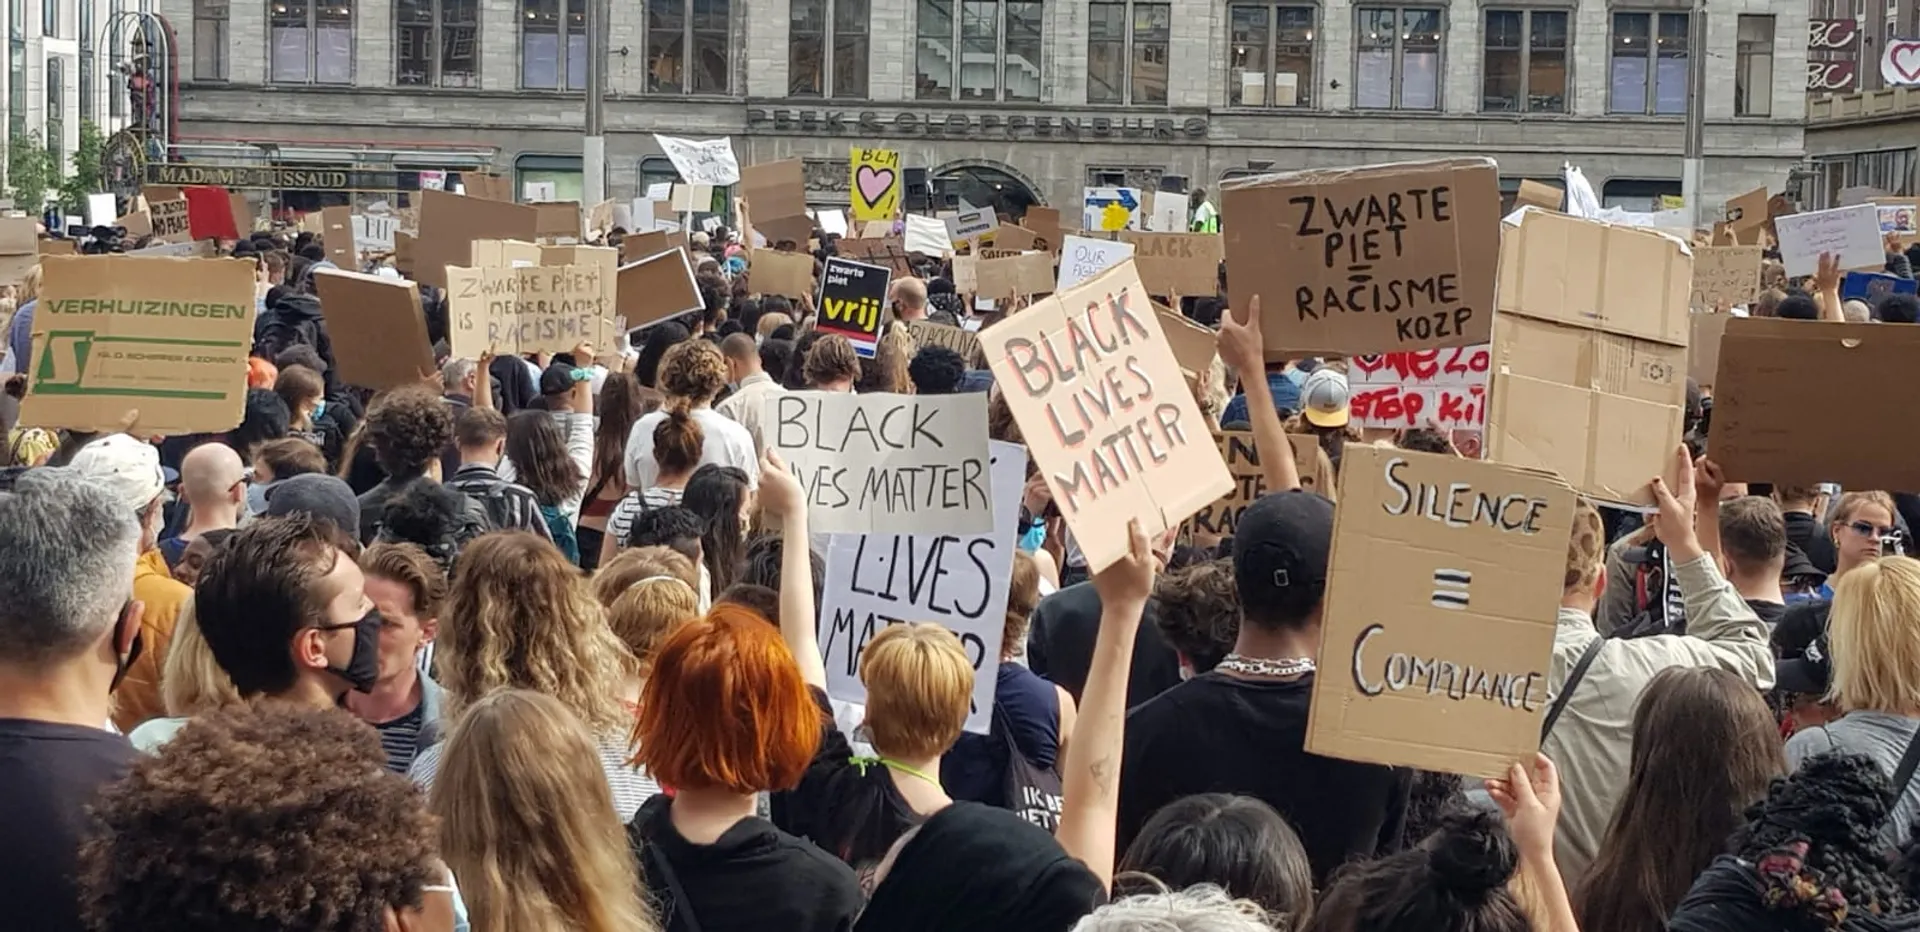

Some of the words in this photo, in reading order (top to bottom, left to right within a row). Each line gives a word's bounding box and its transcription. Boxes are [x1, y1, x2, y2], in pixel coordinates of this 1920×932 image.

[746, 109, 846, 131] PEEK
[858, 111, 886, 132] &
[893, 112, 1209, 138] CLOPPENBURG
[158, 167, 250, 187] MADAME
[257, 169, 346, 188] TUSSAUD
[861, 149, 899, 168] BLM
[152, 217, 166, 237] NO
[1288, 186, 1451, 236] ZWARTE
[1133, 236, 1192, 259] LACK
[1324, 224, 1406, 267] PIET
[827, 276, 849, 286] piet
[829, 265, 865, 278] zwarte
[47, 300, 246, 319] VERHUIZINGEN
[824, 297, 880, 332] vrij
[1296, 273, 1460, 321] RACISME
[1004, 287, 1150, 398] BLACK
[1396, 307, 1472, 342] KOZP
[1046, 355, 1154, 448] LIVES
[777, 396, 944, 452] BLACK
[1053, 403, 1186, 513] MATTER
[858, 459, 989, 513] MATTER
[1382, 458, 1549, 535] SILENCE
[850, 534, 995, 619] LIVES
[1352, 622, 1543, 713] COMPLIANCE
[1023, 785, 1046, 807] IK
